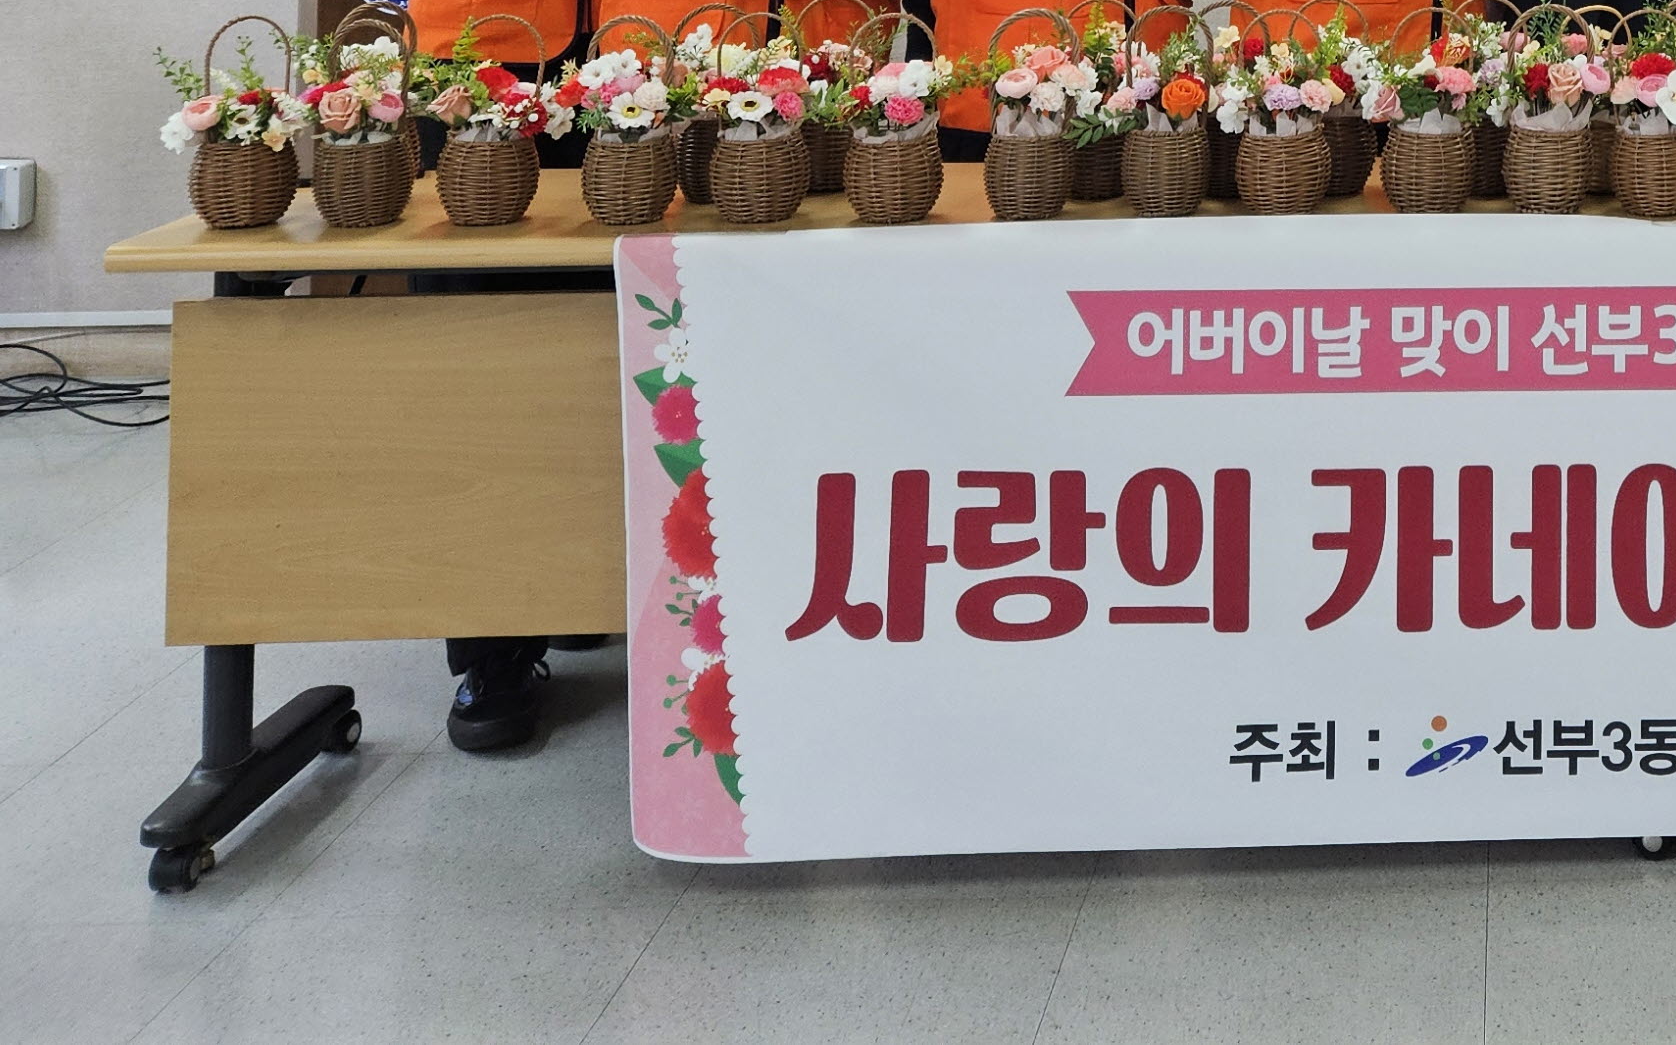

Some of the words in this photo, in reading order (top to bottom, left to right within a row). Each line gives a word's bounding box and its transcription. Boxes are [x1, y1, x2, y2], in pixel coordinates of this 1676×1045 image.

[1125, 305, 1372, 379] 어버이날
[1390, 304, 1511, 378] 맞이
[784, 467, 1252, 643] 사랑의
[1228, 720, 1337, 783] 주최
